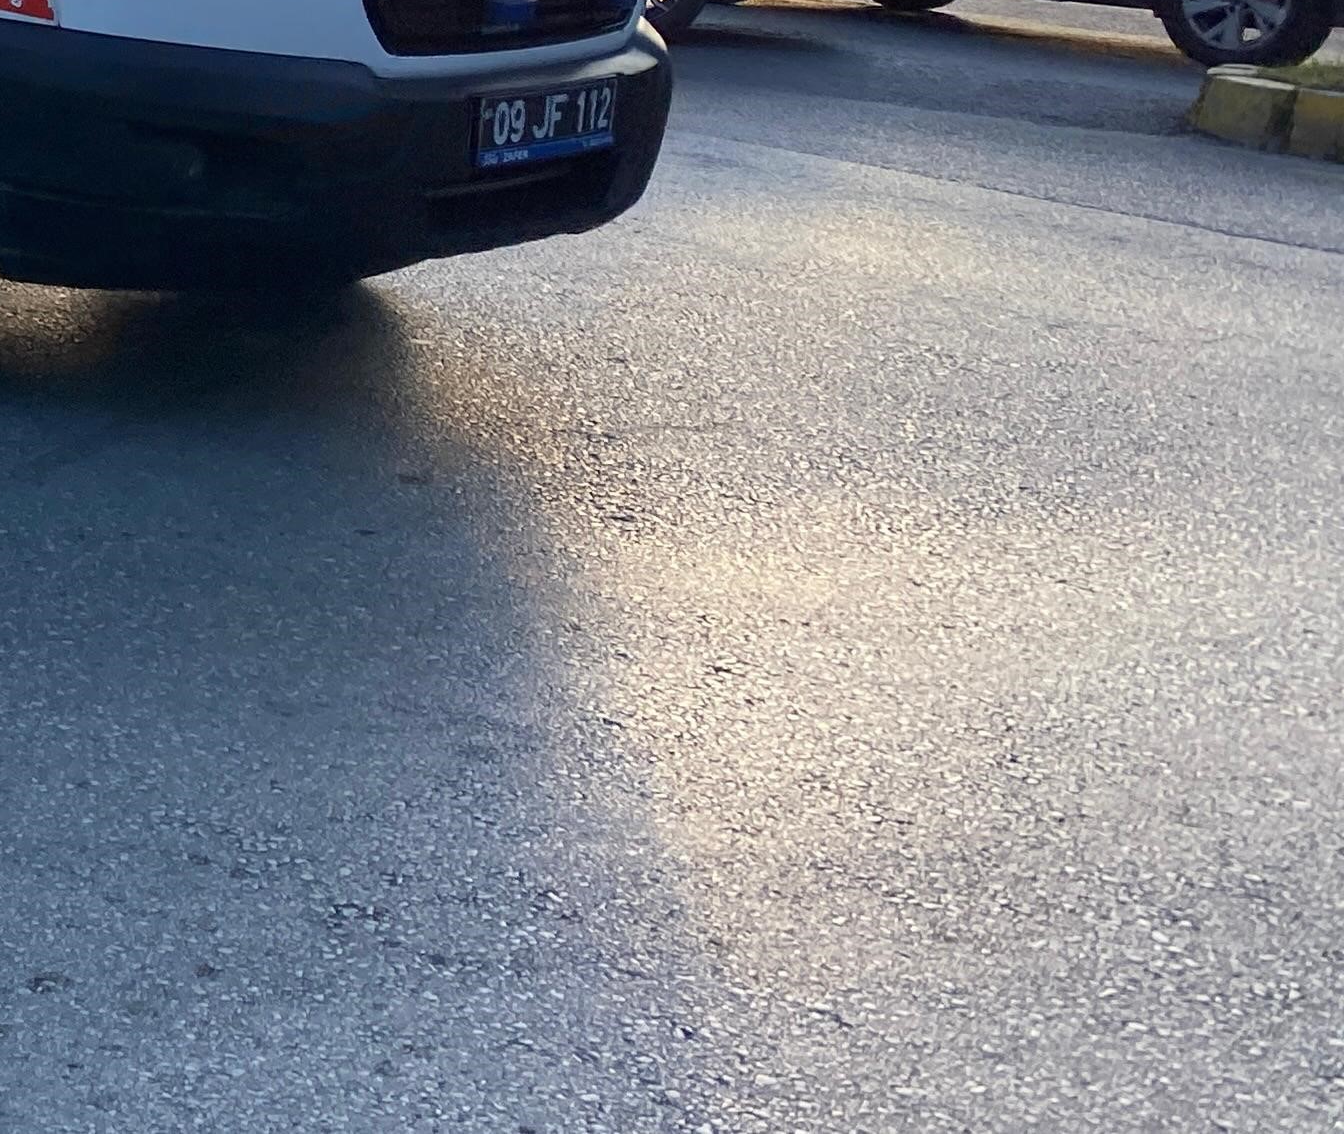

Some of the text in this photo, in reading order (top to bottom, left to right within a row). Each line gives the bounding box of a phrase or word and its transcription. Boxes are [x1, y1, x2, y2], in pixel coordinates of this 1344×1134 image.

[493, 86, 611, 146] 09 JF 112
